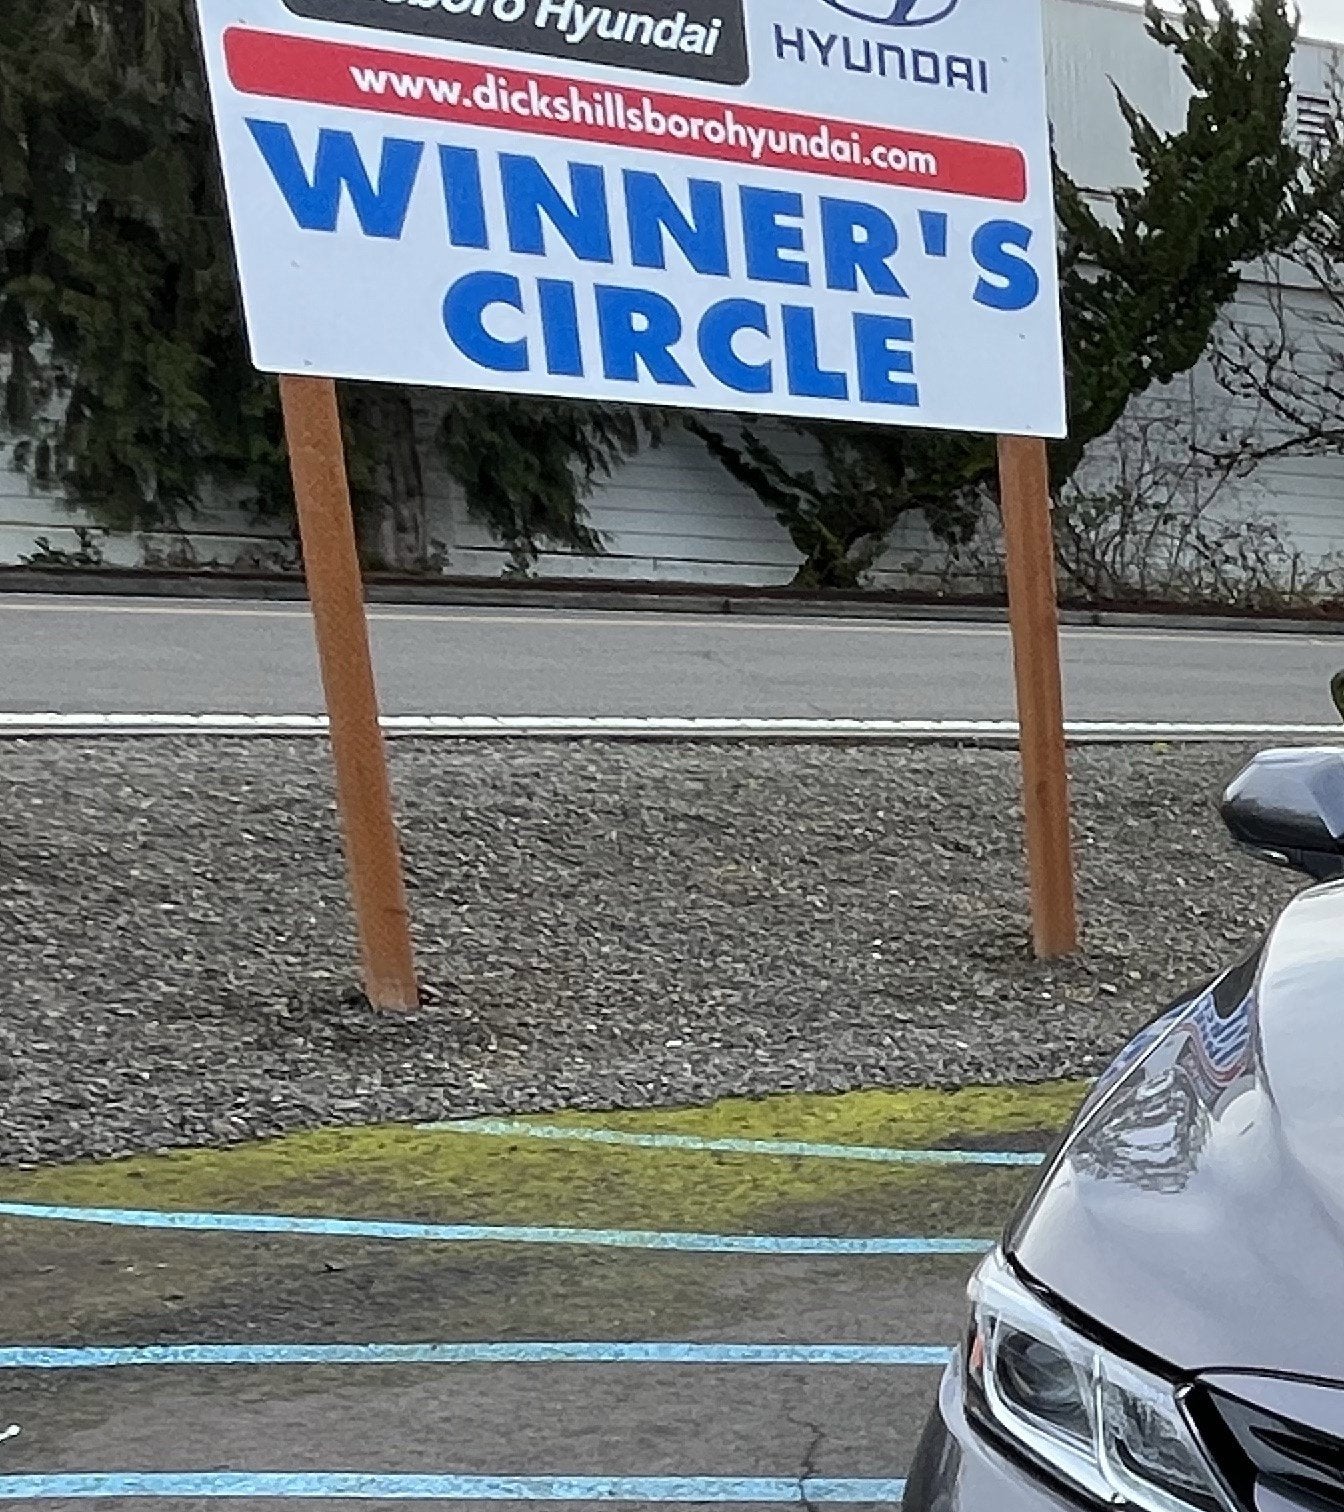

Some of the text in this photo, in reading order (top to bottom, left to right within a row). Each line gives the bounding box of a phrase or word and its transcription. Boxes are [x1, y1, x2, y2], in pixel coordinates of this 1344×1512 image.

[535, 0, 722, 57] Hyundai
[772, 22, 990, 94] HYUNDAI
[348, 60, 939, 177] www.dickshillsborohyundai.com
[244, 116, 1041, 312] WINNER'S
[442, 270, 921, 408] CIRCLE
